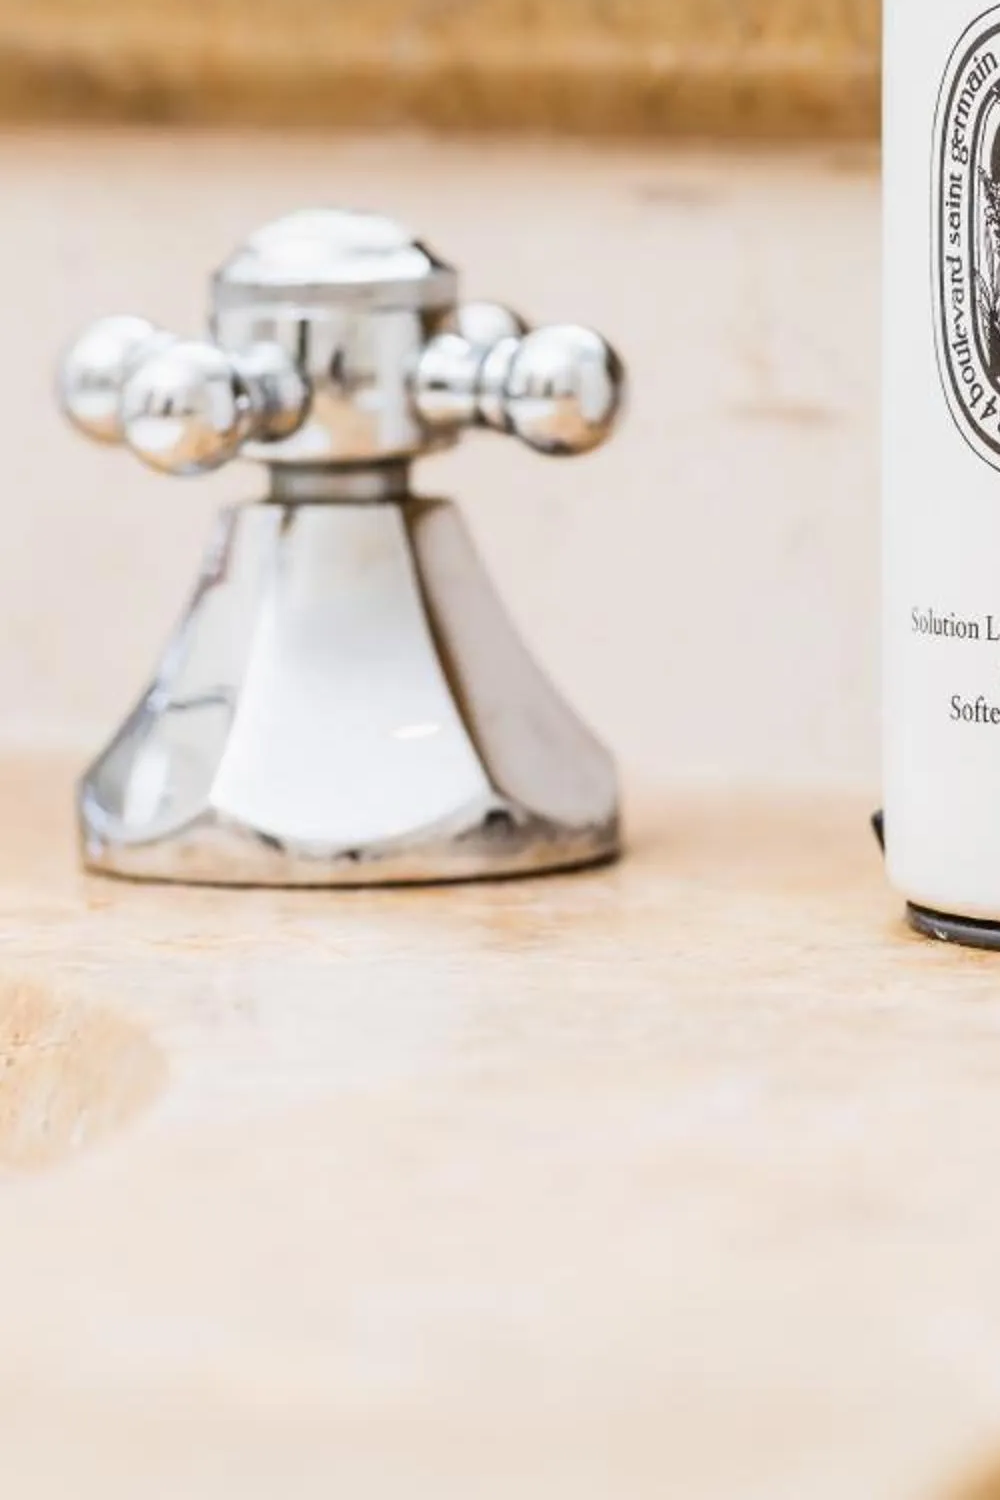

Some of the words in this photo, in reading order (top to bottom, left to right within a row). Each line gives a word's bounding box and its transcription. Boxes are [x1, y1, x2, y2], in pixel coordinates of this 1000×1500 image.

[950, 50, 999, 165] germain
[945, 172, 964, 249] saint
[911, 605, 980, 641] Solution
